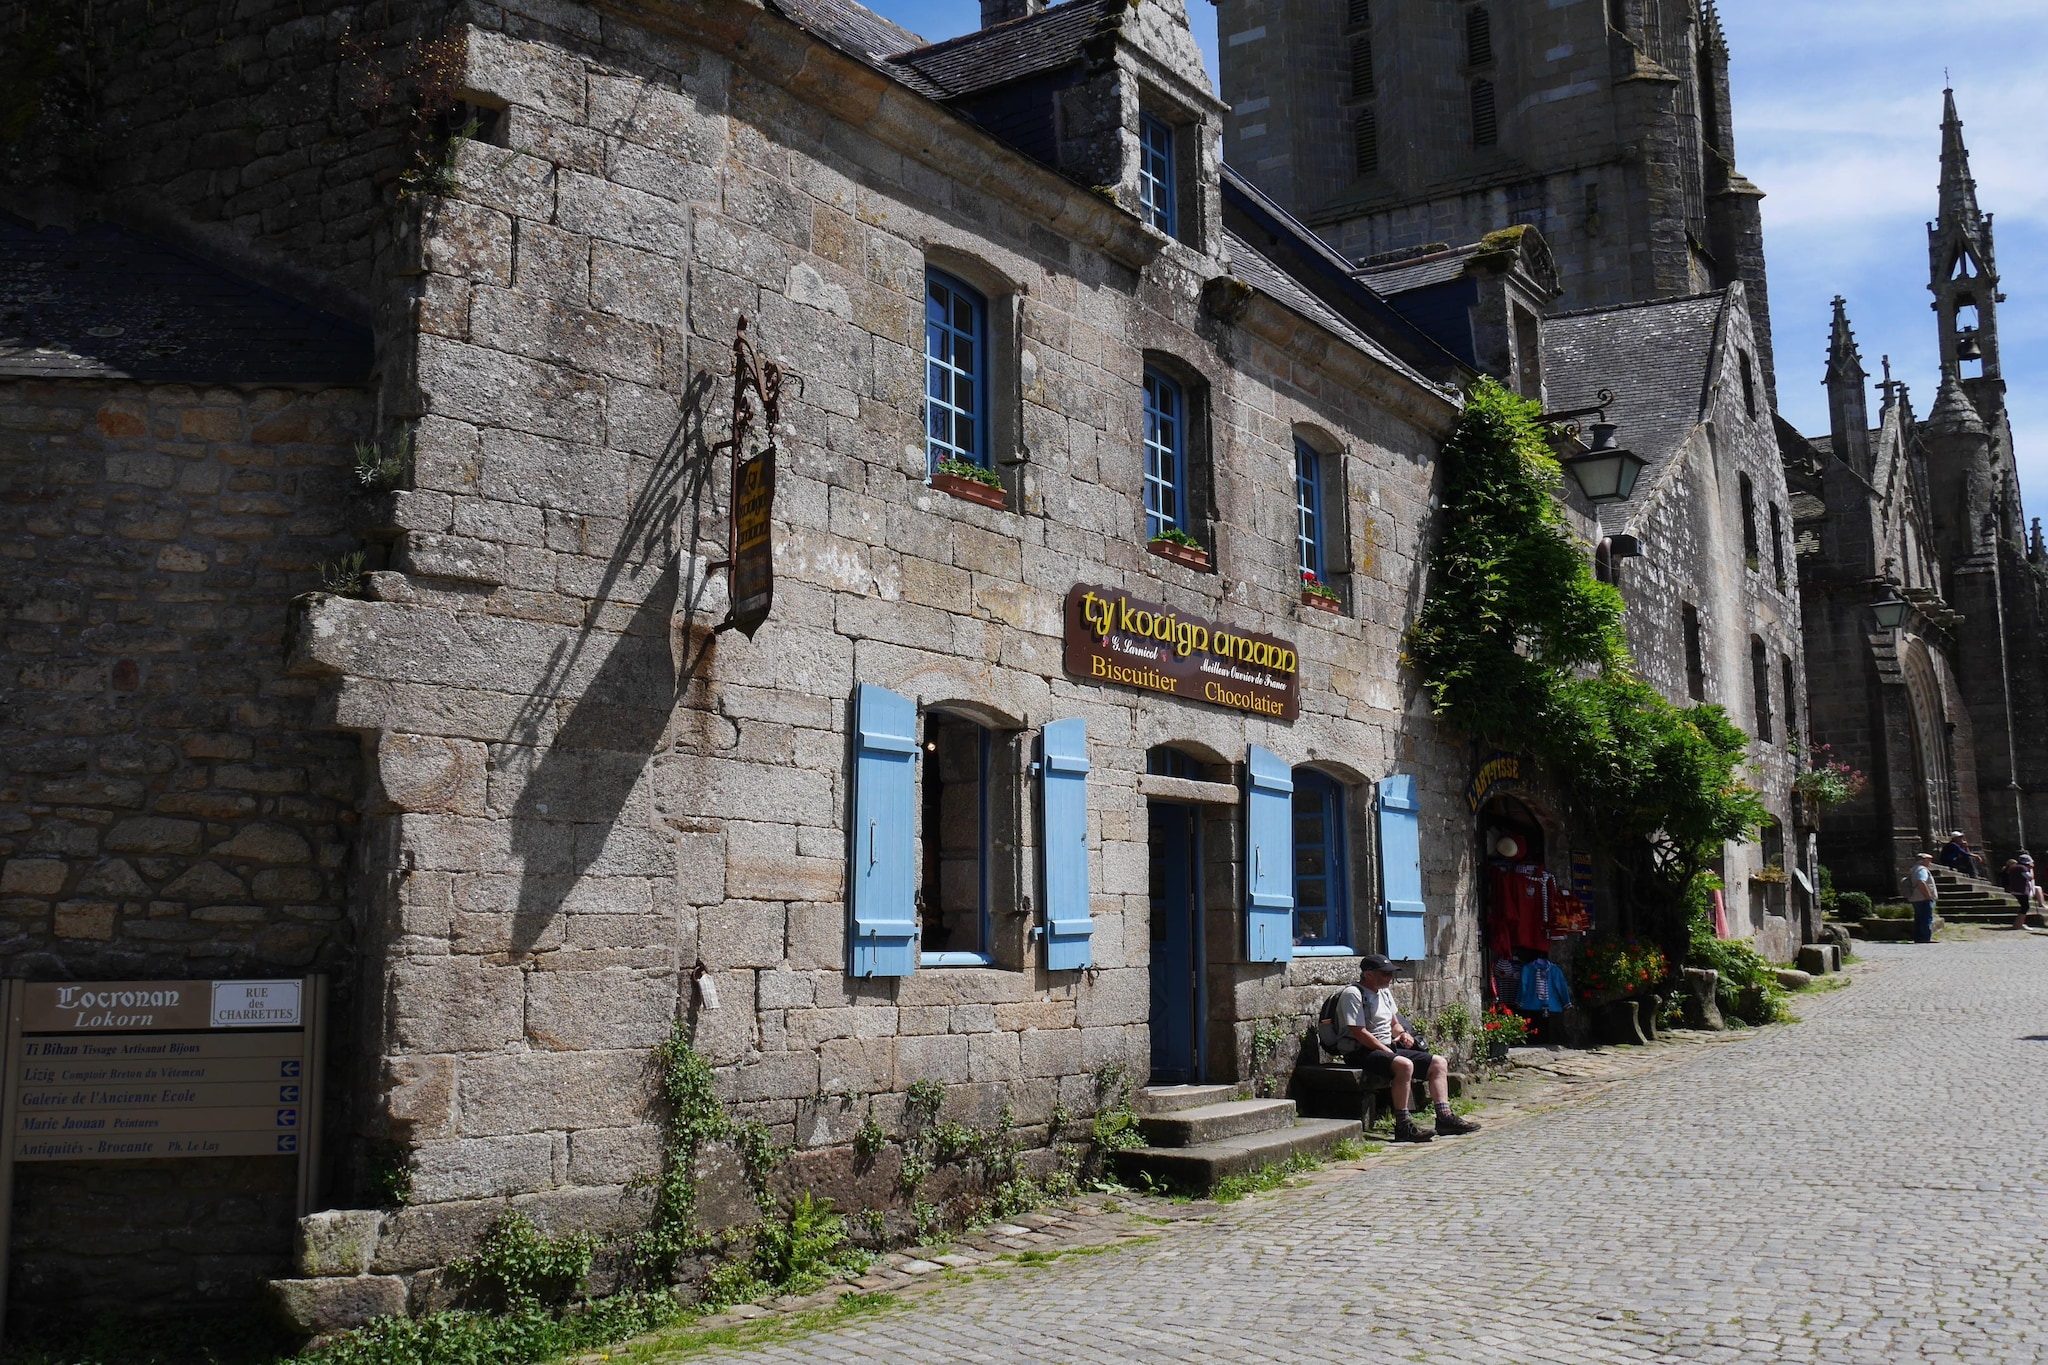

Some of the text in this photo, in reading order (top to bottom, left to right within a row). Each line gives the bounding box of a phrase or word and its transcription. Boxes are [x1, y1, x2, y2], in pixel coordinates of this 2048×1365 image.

[1082, 591, 1296, 673] ty kouign amann
[1112, 635, 1159, 660] G. Larnicol
[1091, 654, 1177, 692] Biscuitier
[1200, 658, 1287, 691] Meilleur Ouvrier de France
[1204, 681, 1284, 715] Chocolatier
[56, 986, 180, 1009] Locronan
[245, 987, 269, 998] RUE
[248, 999, 264, 1009] des
[74, 1010, 154, 1027] Lokorn
[219, 1008, 293, 1020] CHARRETTES
[26, 1042, 201, 1056] Ti Bihan Tissage Artisanat Bijoux
[24, 1068, 55, 1083] Lizig
[62, 1070, 107, 1082] Comptoir
[110, 1069, 142, 1079] Breton
[145, 1068, 157, 1078] du
[22, 1089, 196, 1106] Galerie de l'Ancienne Ecole
[21, 1117, 159, 1130] Marie Jaouan Peintures
[20, 1142, 84, 1158] Antiquités
[98, 1140, 153, 1154] Brocante
[168, 1141, 183, 1152] Ph.
[187, 1141, 199, 1152] Le
